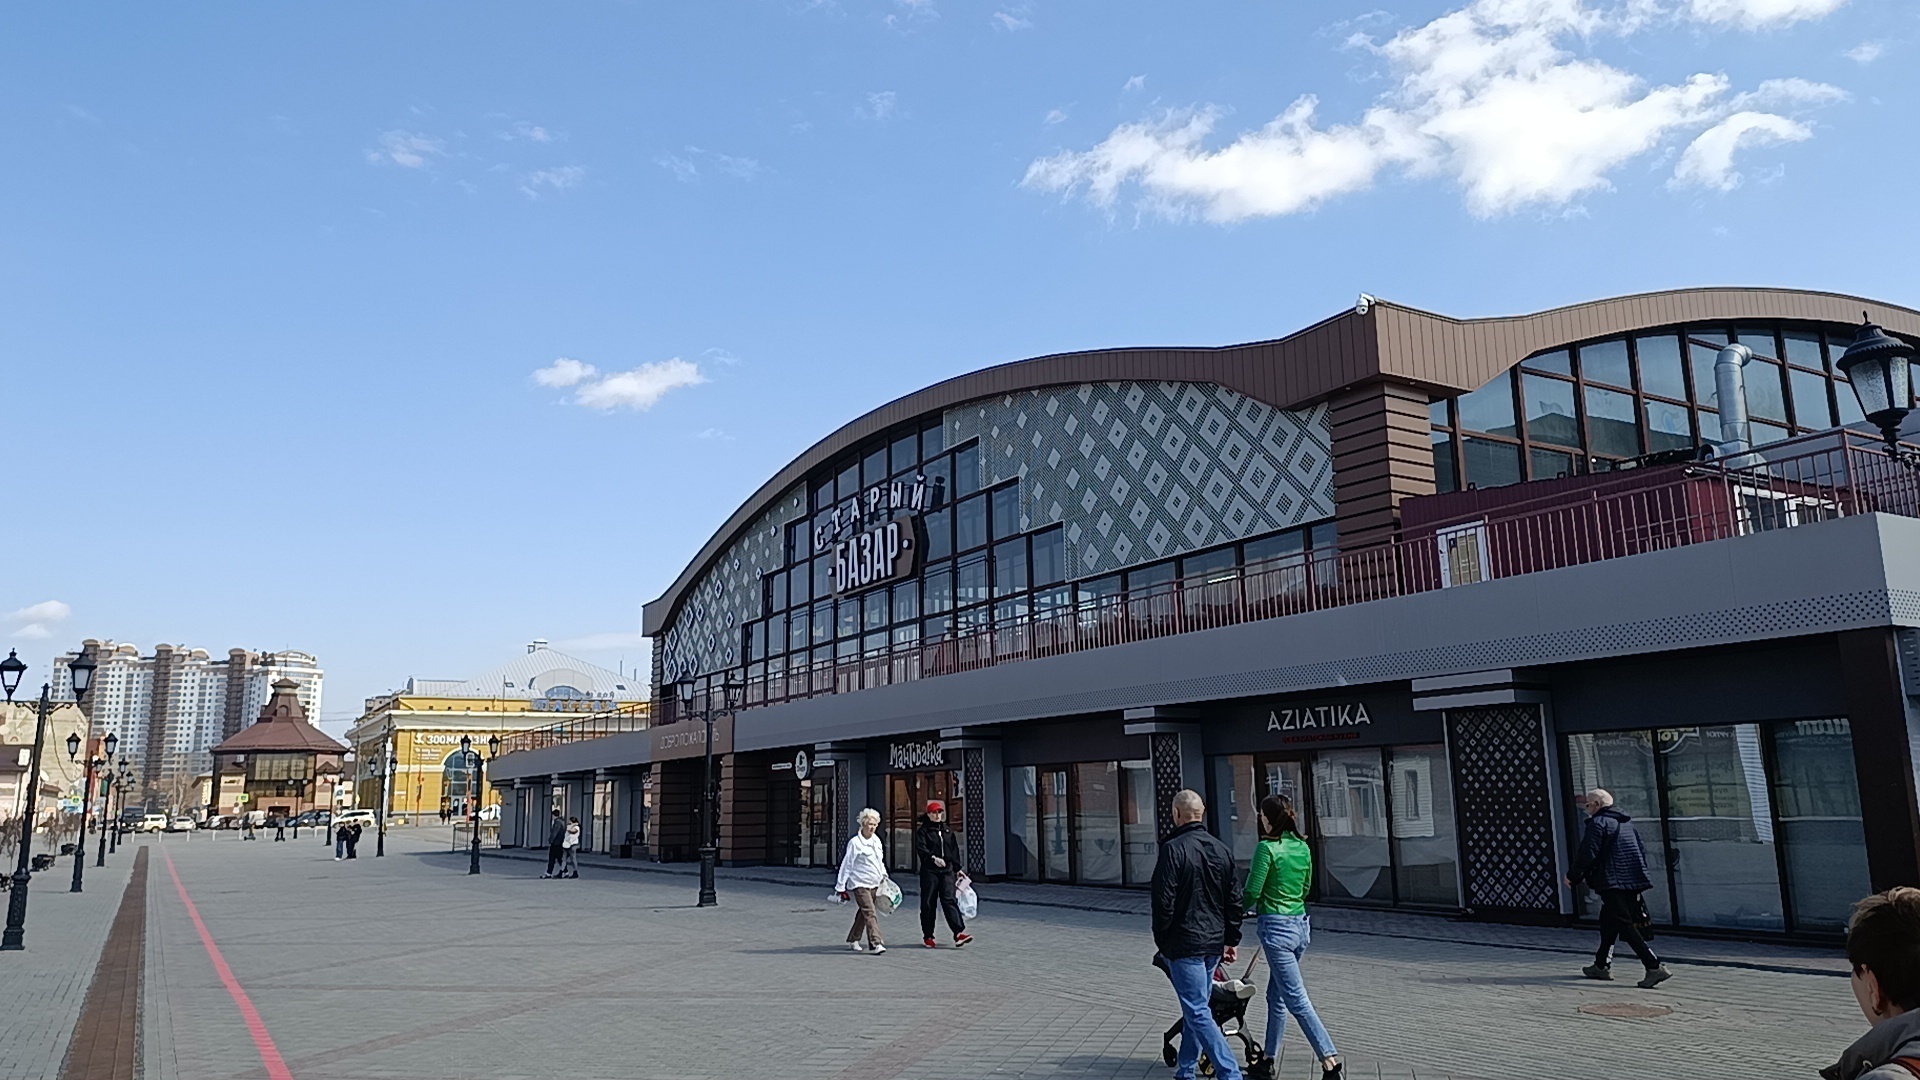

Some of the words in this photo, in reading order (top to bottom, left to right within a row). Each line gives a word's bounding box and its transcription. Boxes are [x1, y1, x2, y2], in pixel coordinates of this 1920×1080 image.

[814, 475, 924, 551] СТАРЫЙ
[835, 522, 899, 594] БАЗАР
[1267, 702, 1371, 732] AZIATIKA
